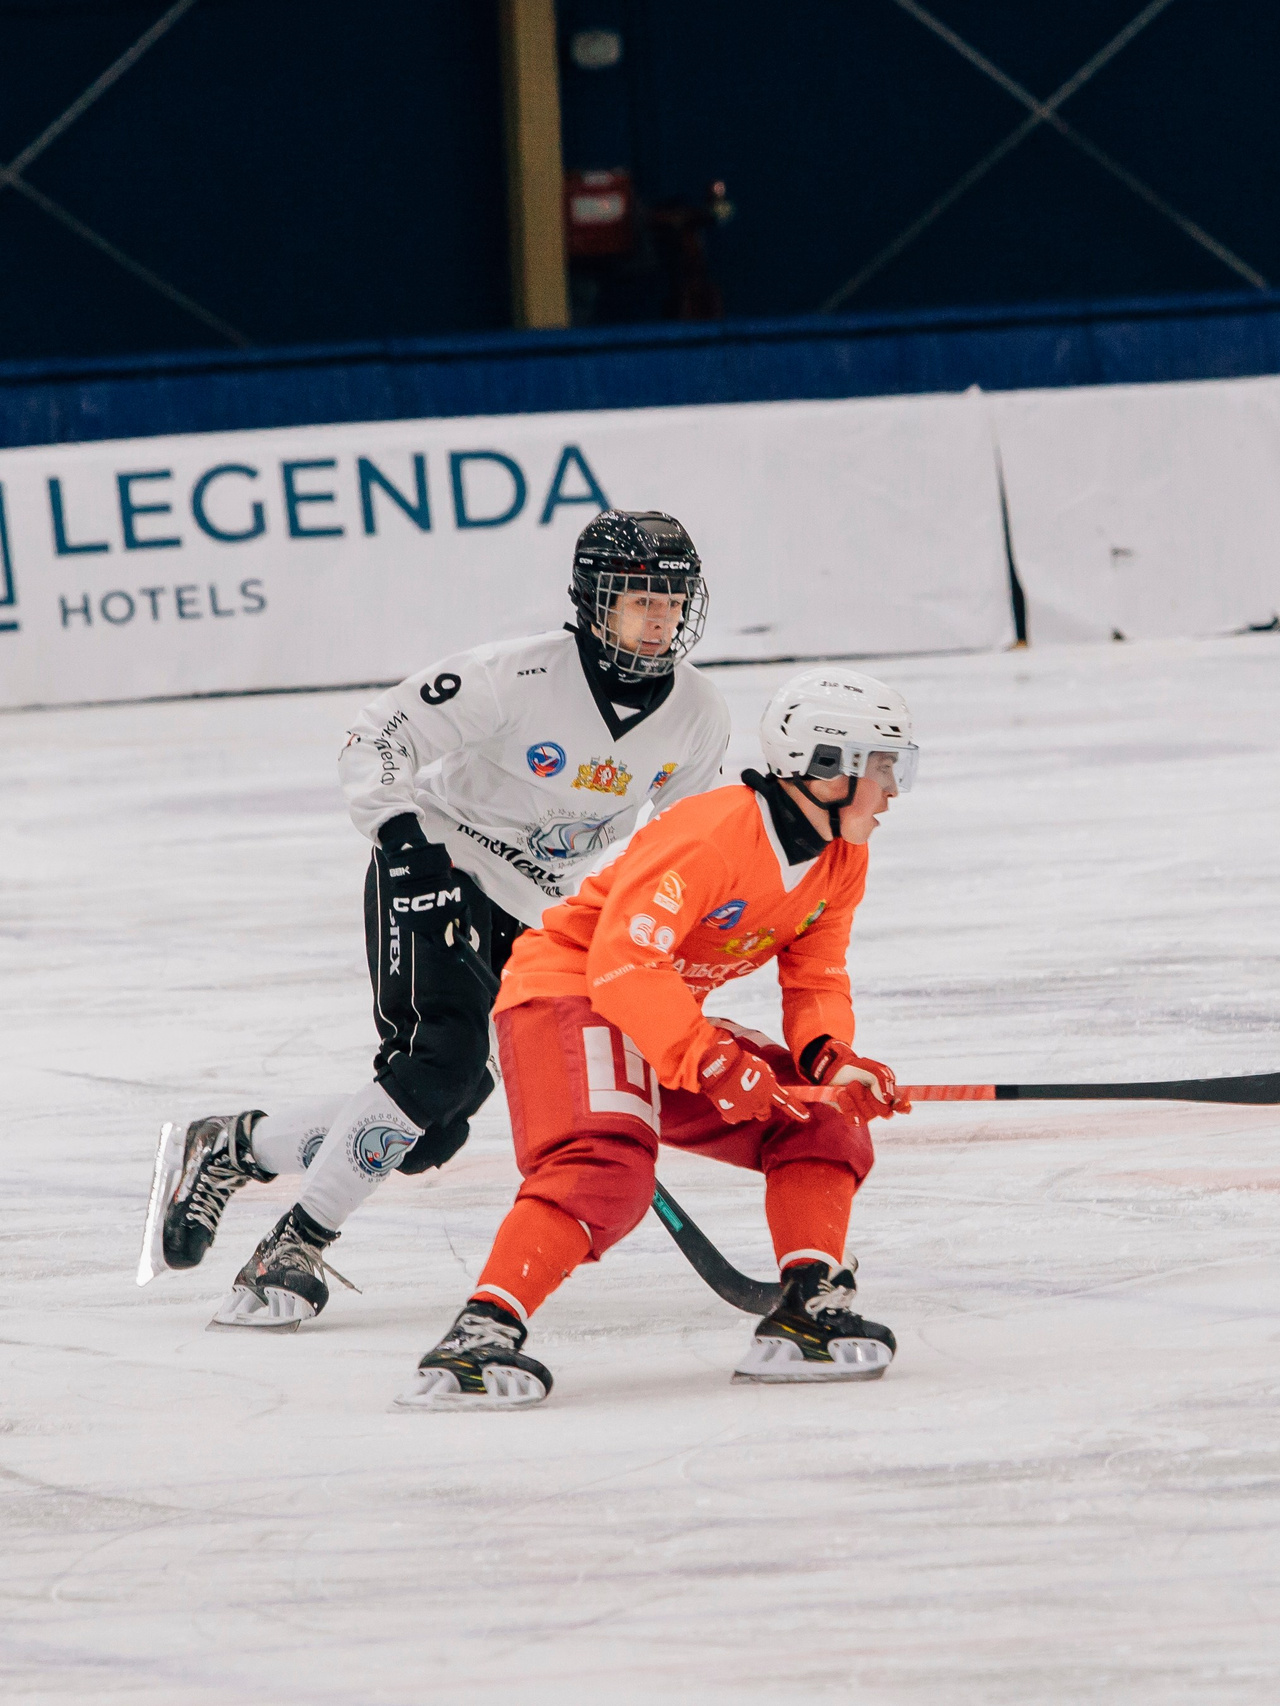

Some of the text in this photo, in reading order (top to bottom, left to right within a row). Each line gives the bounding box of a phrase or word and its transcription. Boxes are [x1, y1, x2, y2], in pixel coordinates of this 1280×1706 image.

[46, 443, 613, 558] LEGENDA
[658, 560, 691, 571] CCM
[59, 578, 268, 629] HOTELS
[516, 667, 548, 678] STEX
[419, 672, 462, 706] 9
[393, 886, 462, 913] CCM
